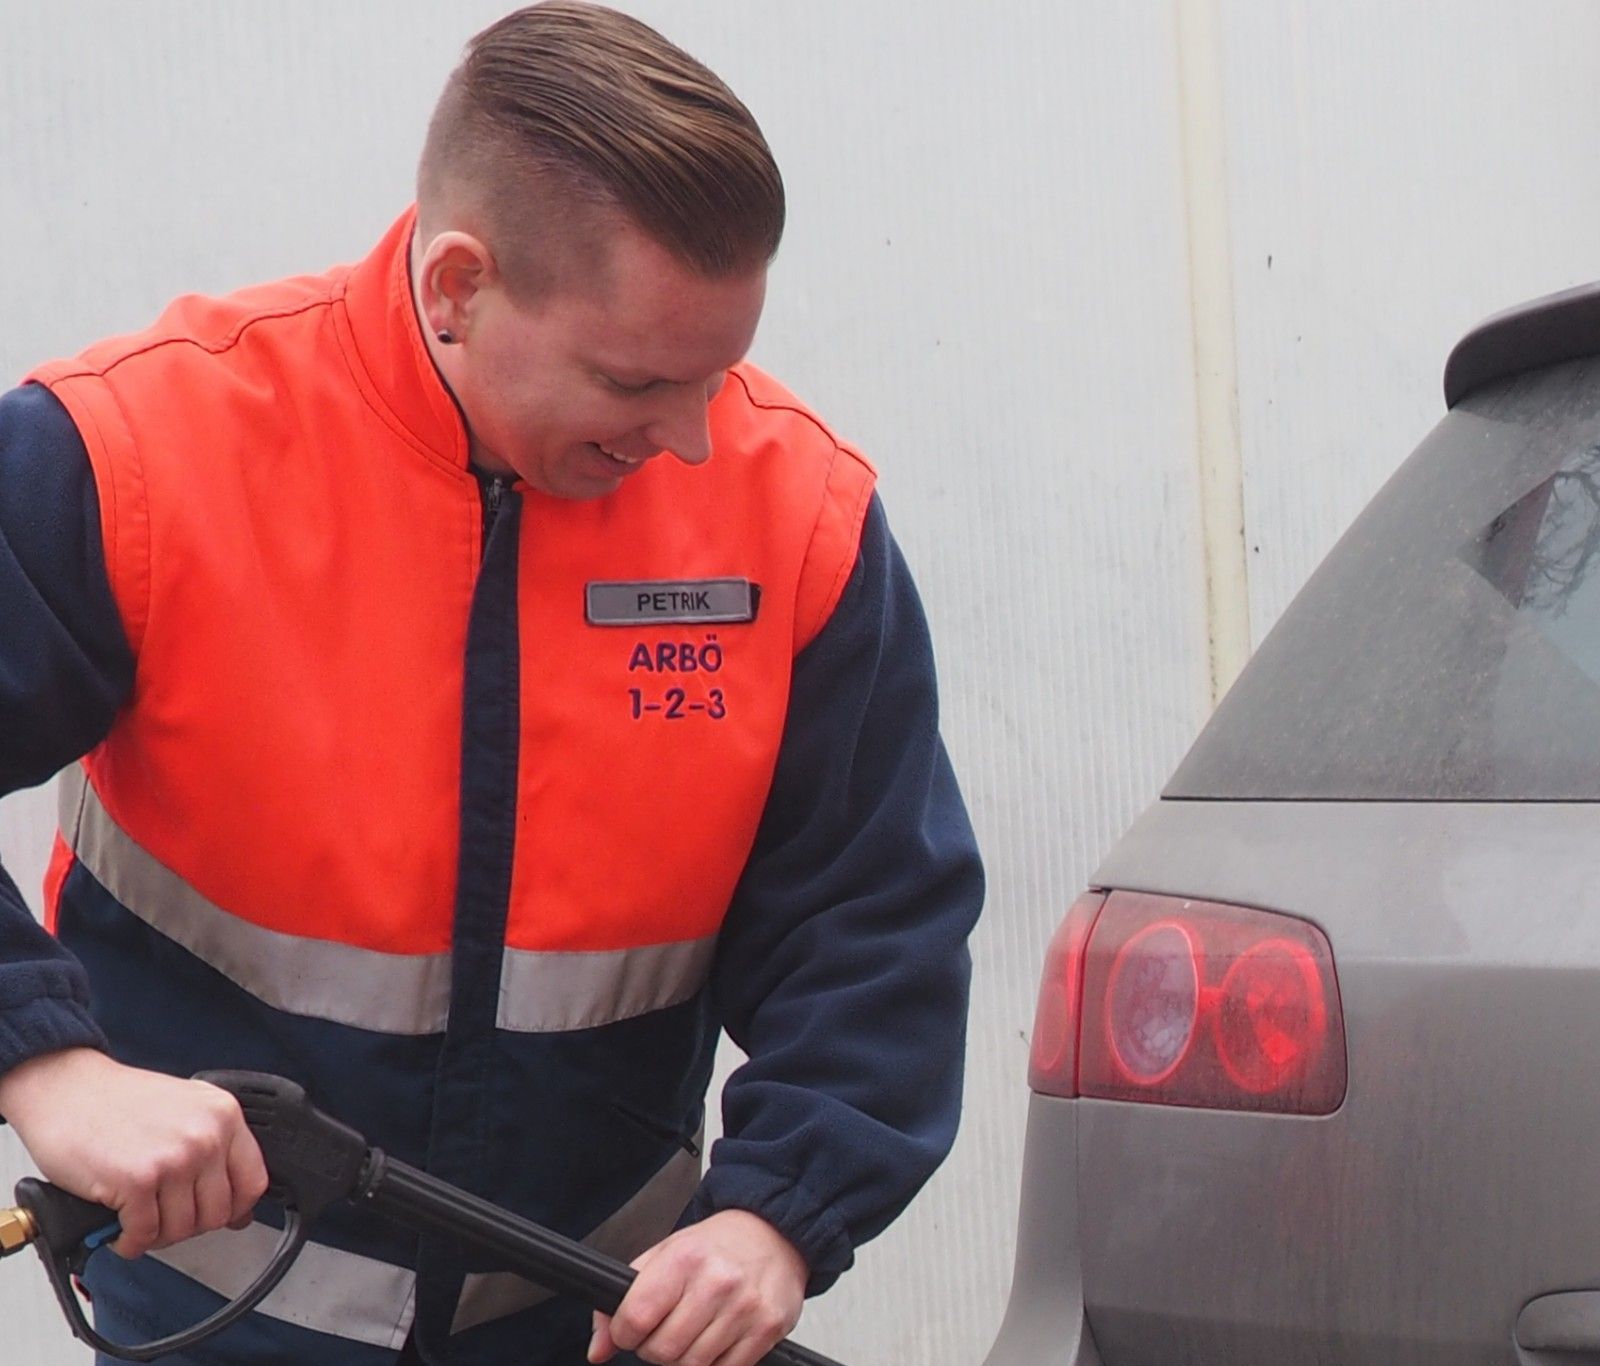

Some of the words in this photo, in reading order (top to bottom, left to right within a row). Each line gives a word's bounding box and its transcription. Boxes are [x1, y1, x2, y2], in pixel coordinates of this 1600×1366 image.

[637, 591, 711, 612] PETRIK
[628, 633, 722, 673] ARBÖ
[627, 687, 726, 720] 1-2-3
